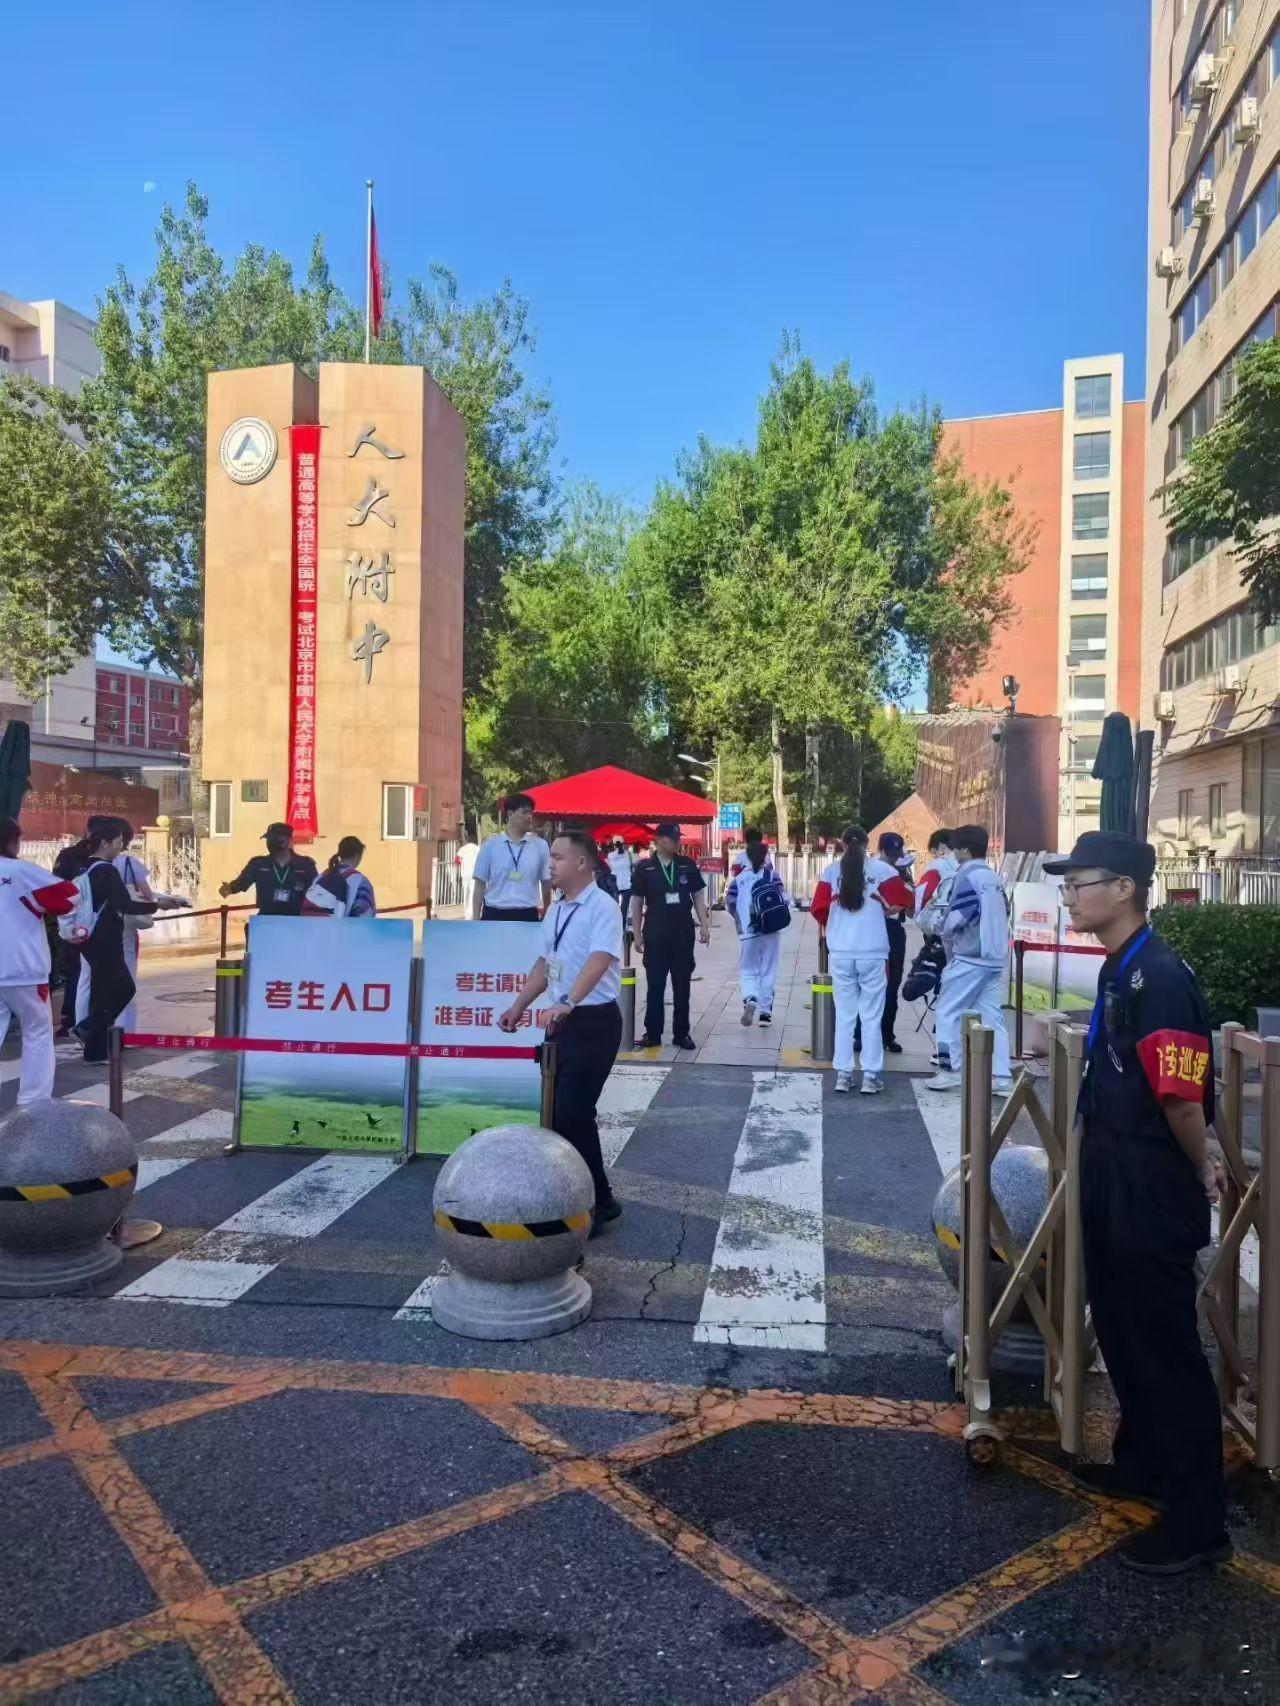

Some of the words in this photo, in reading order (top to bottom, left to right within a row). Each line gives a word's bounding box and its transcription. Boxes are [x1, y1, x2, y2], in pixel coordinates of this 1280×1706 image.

[346, 425, 405, 684] 人大附中
[265, 980, 391, 1012] 考生入口
